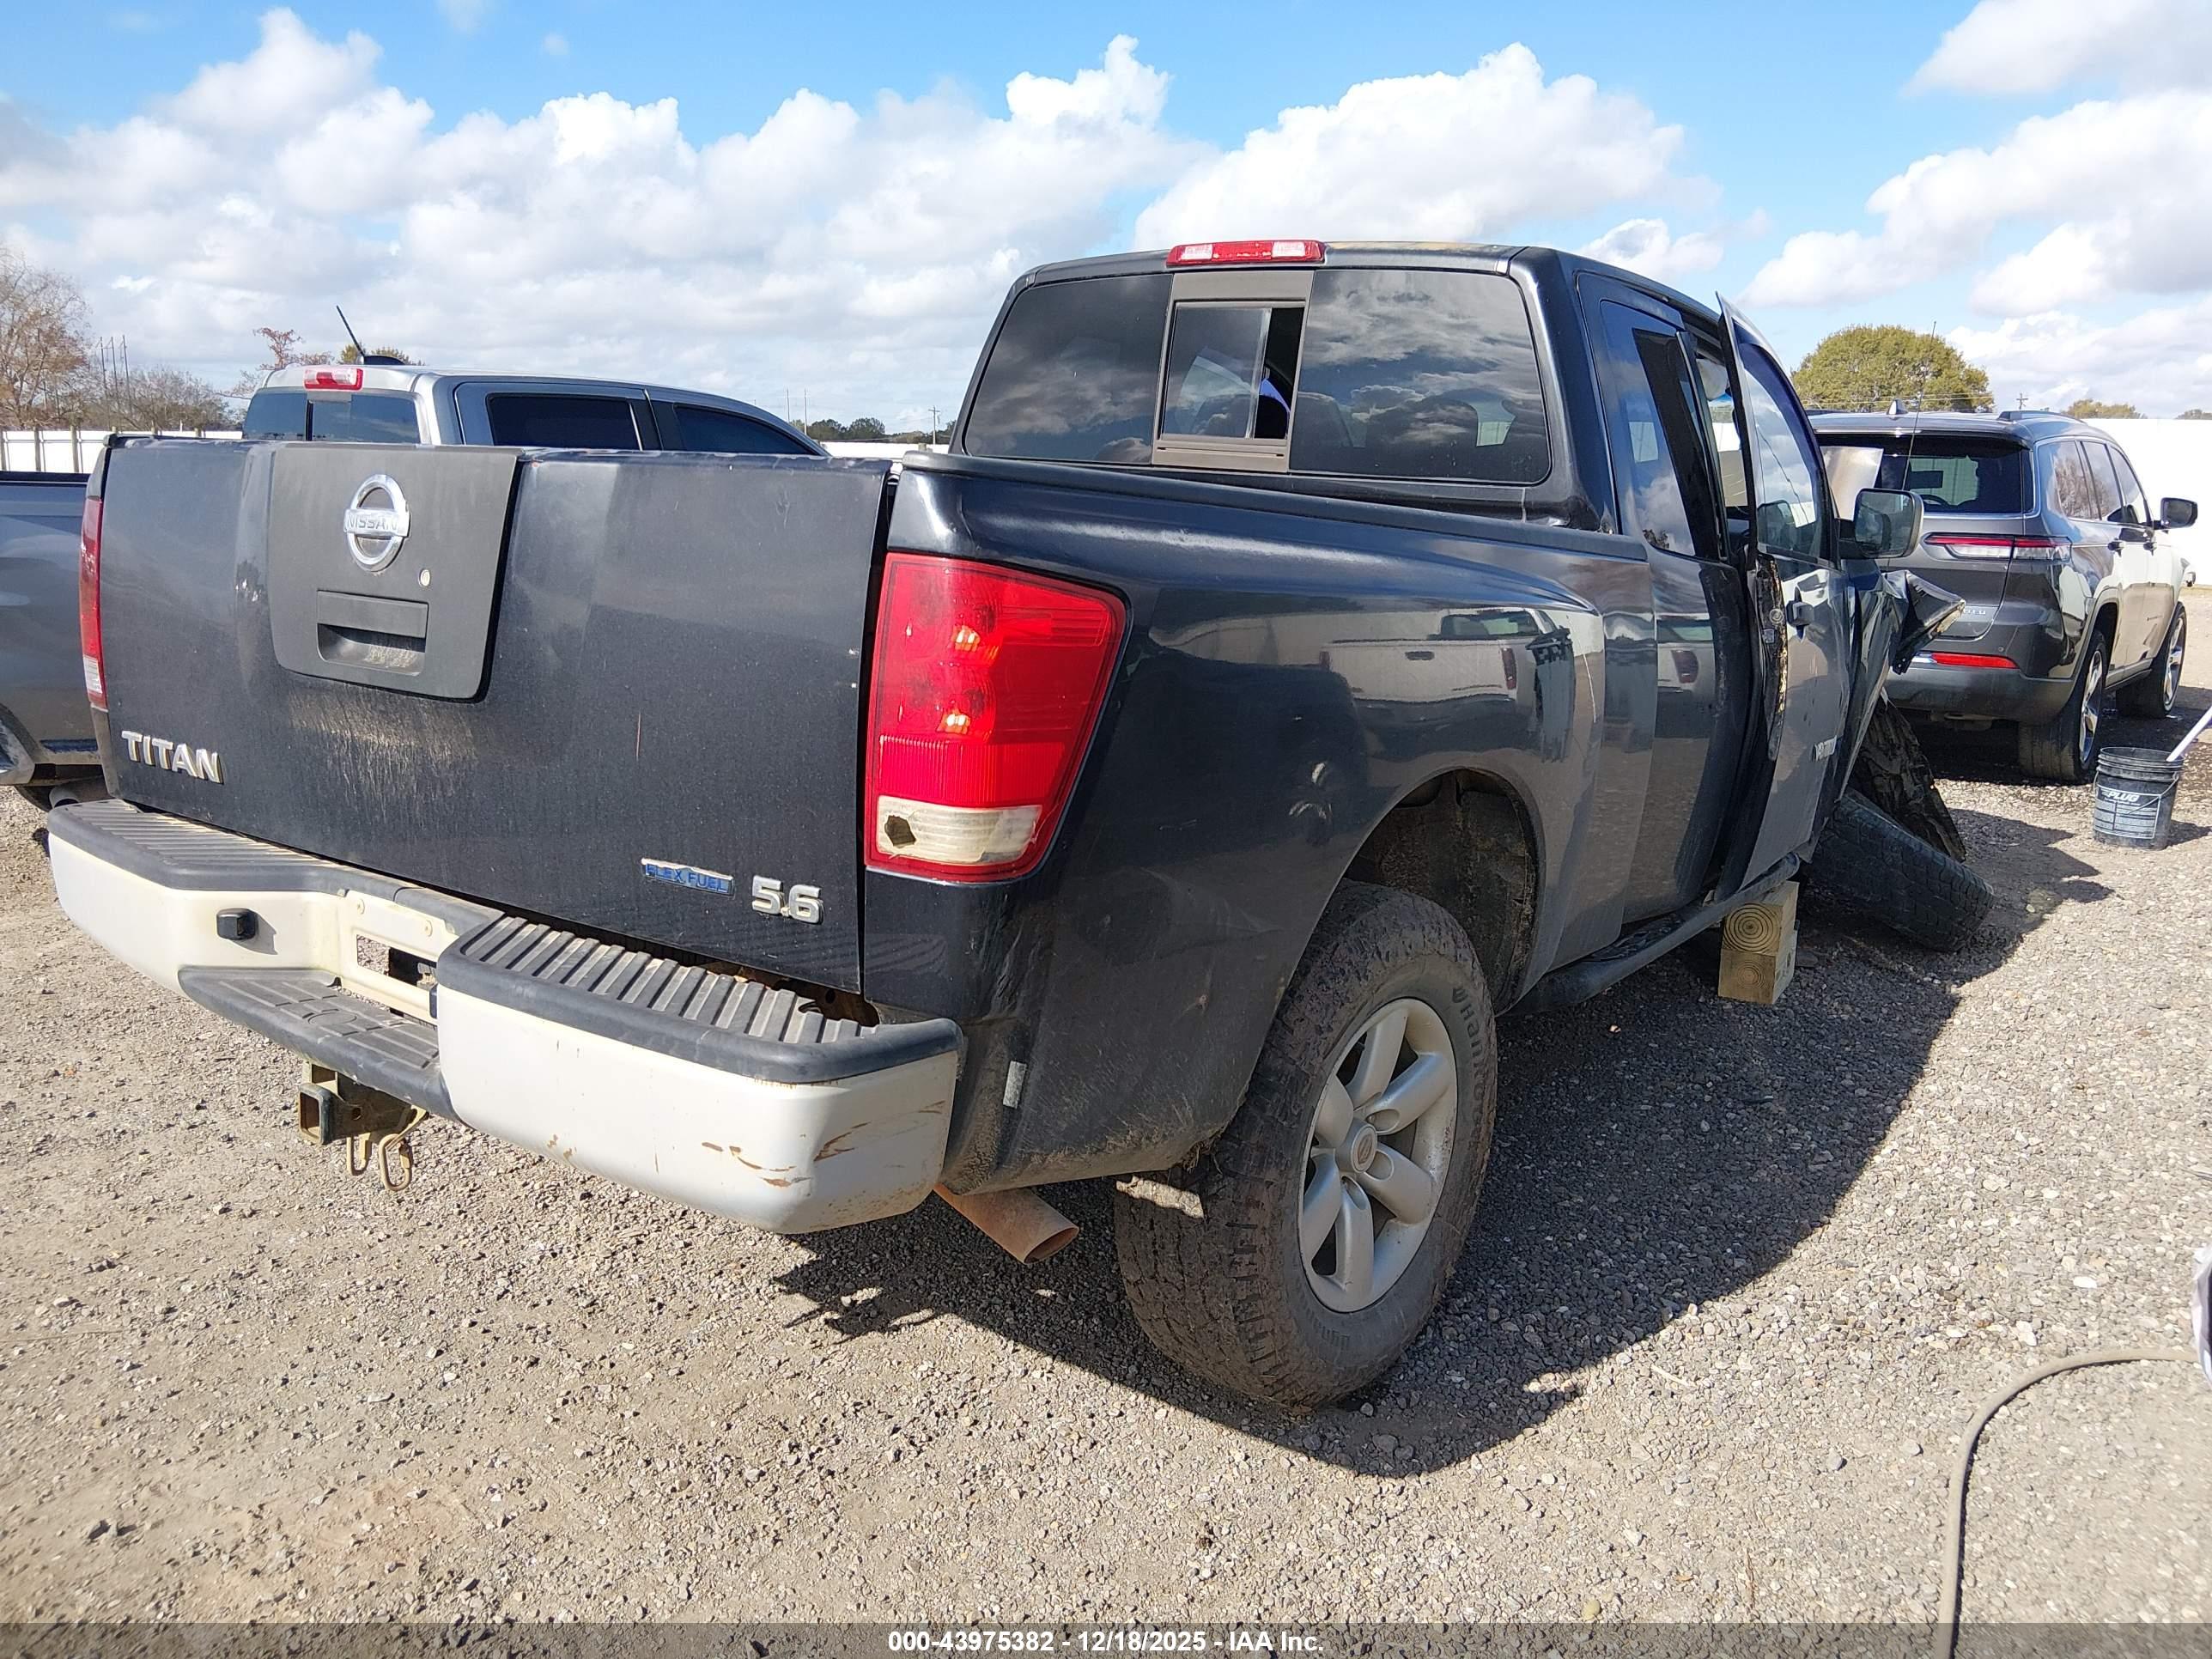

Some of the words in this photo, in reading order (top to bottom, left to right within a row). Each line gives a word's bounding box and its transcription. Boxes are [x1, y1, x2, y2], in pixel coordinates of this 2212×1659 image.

[346, 515, 398, 530] NISSAN
[121, 730, 223, 784] TITAN
[2107, 791, 2140, 802] PLUG
[646, 863, 684, 884] FLEX
[688, 871, 729, 891] FUEL
[752, 874, 823, 925] 5.6
